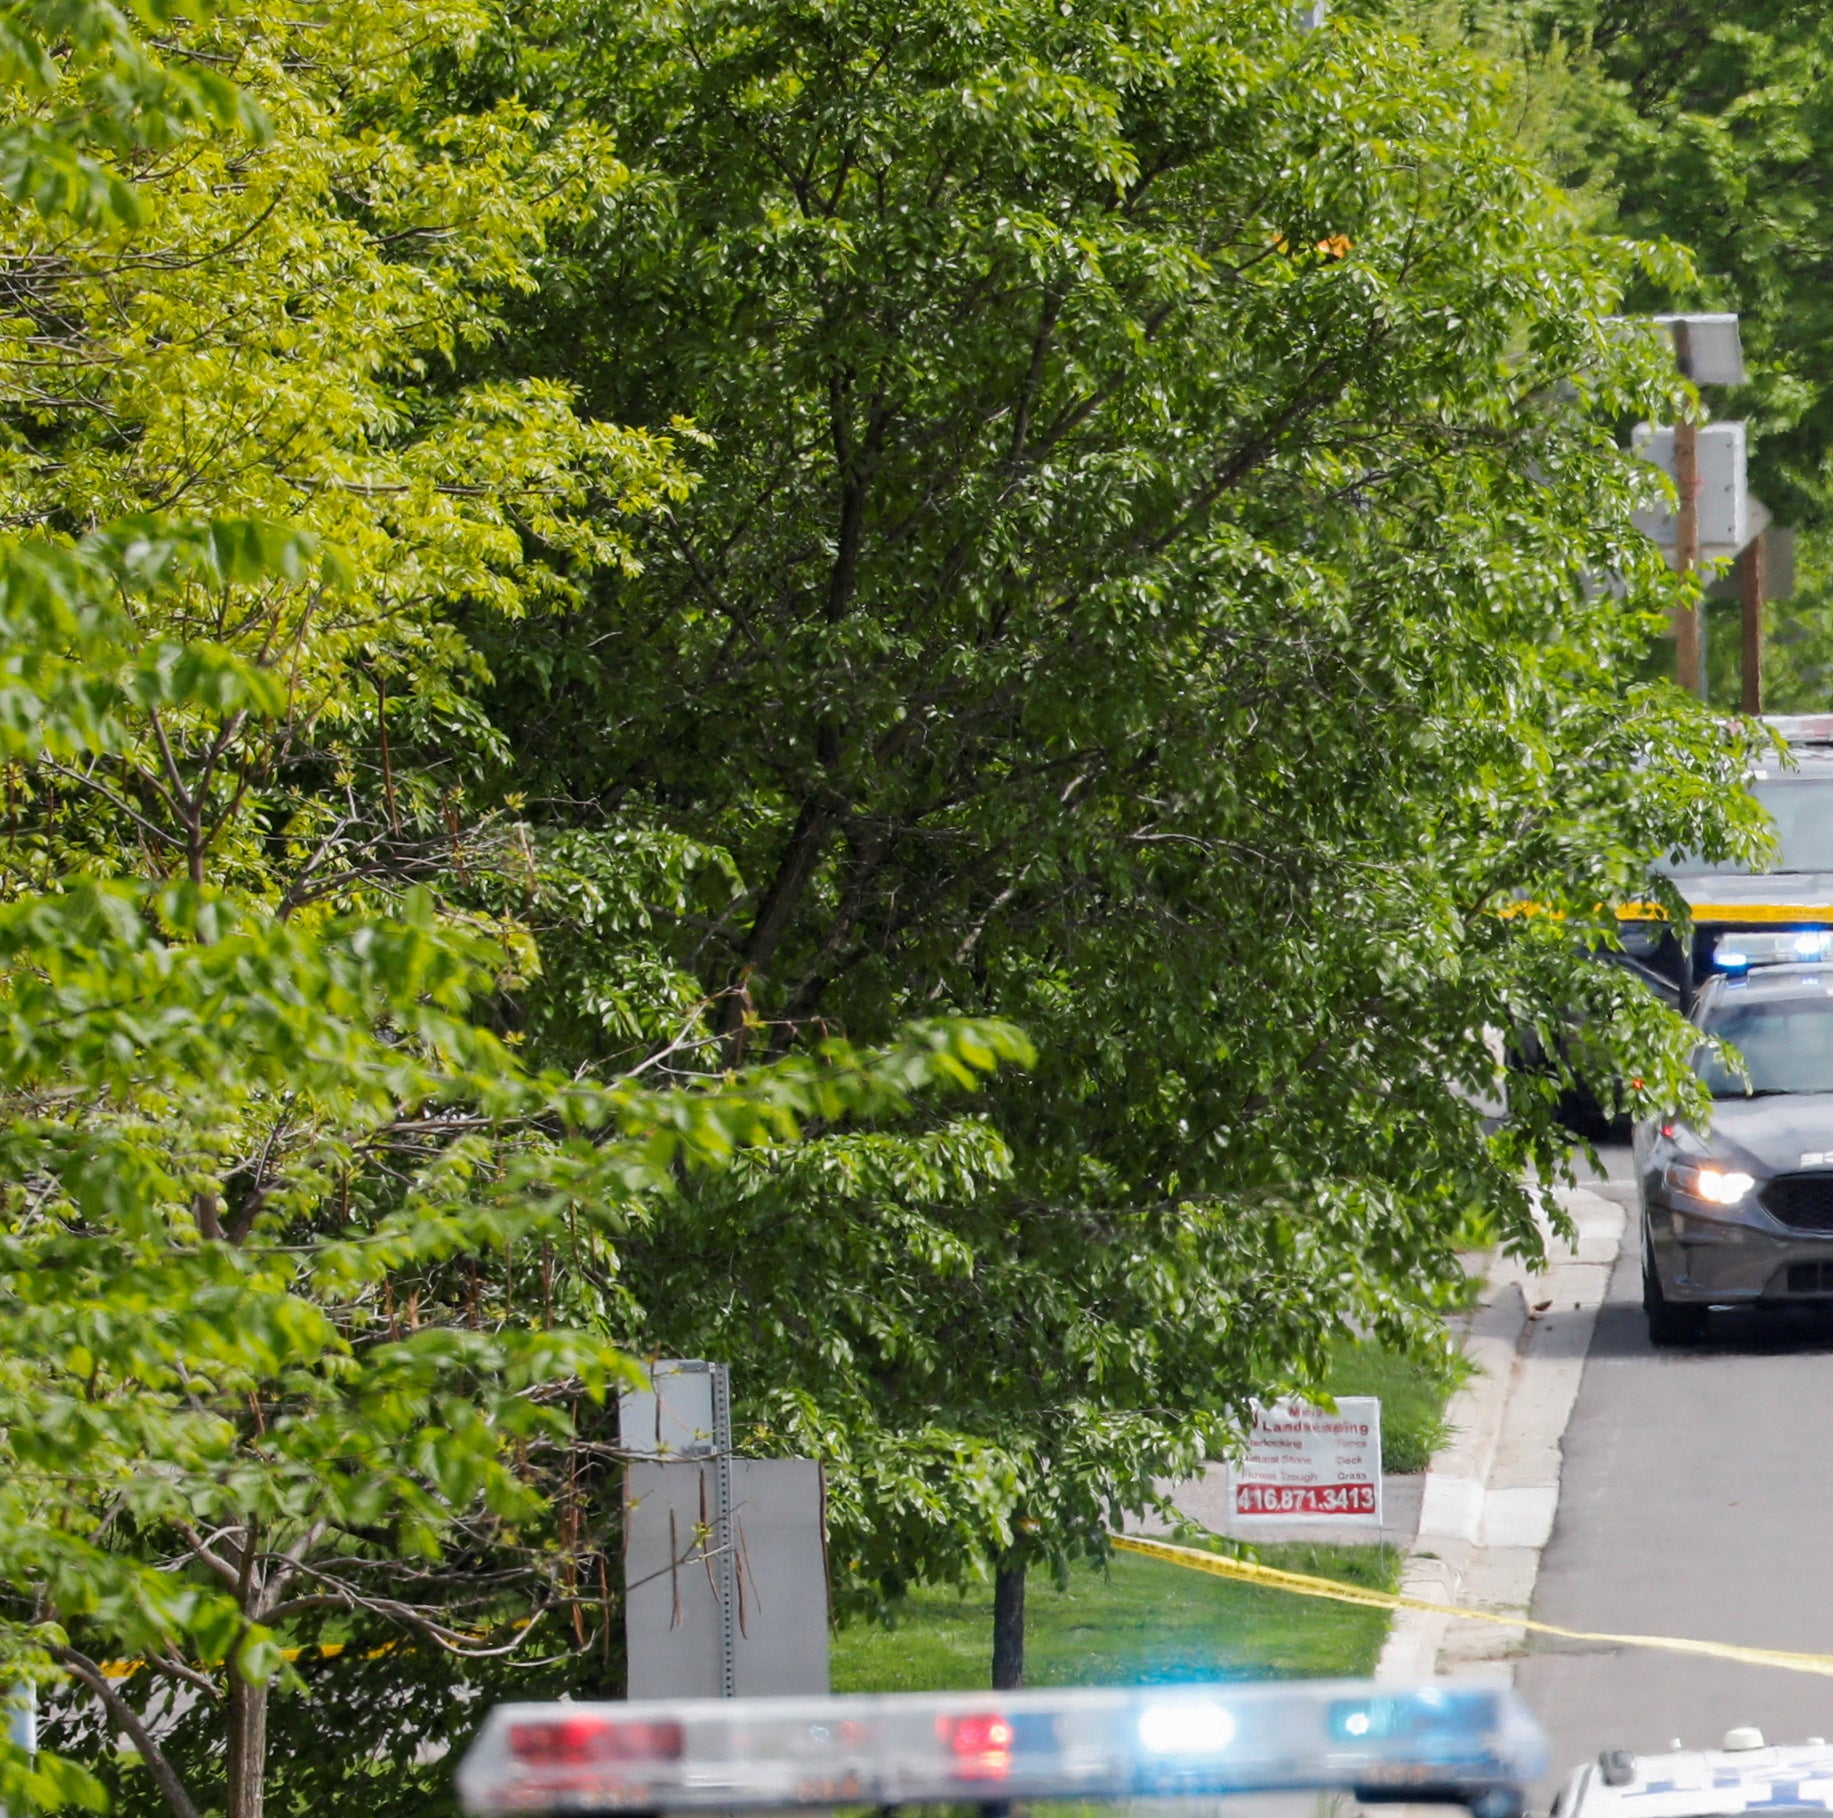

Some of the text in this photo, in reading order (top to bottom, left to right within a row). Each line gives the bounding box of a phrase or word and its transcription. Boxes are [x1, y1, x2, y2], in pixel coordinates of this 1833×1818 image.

[1263, 1420, 1368, 1436] Landscaping
[1337, 1472, 1368, 1481] Grass
[1238, 1487, 1375, 1511] 416.871.3413
